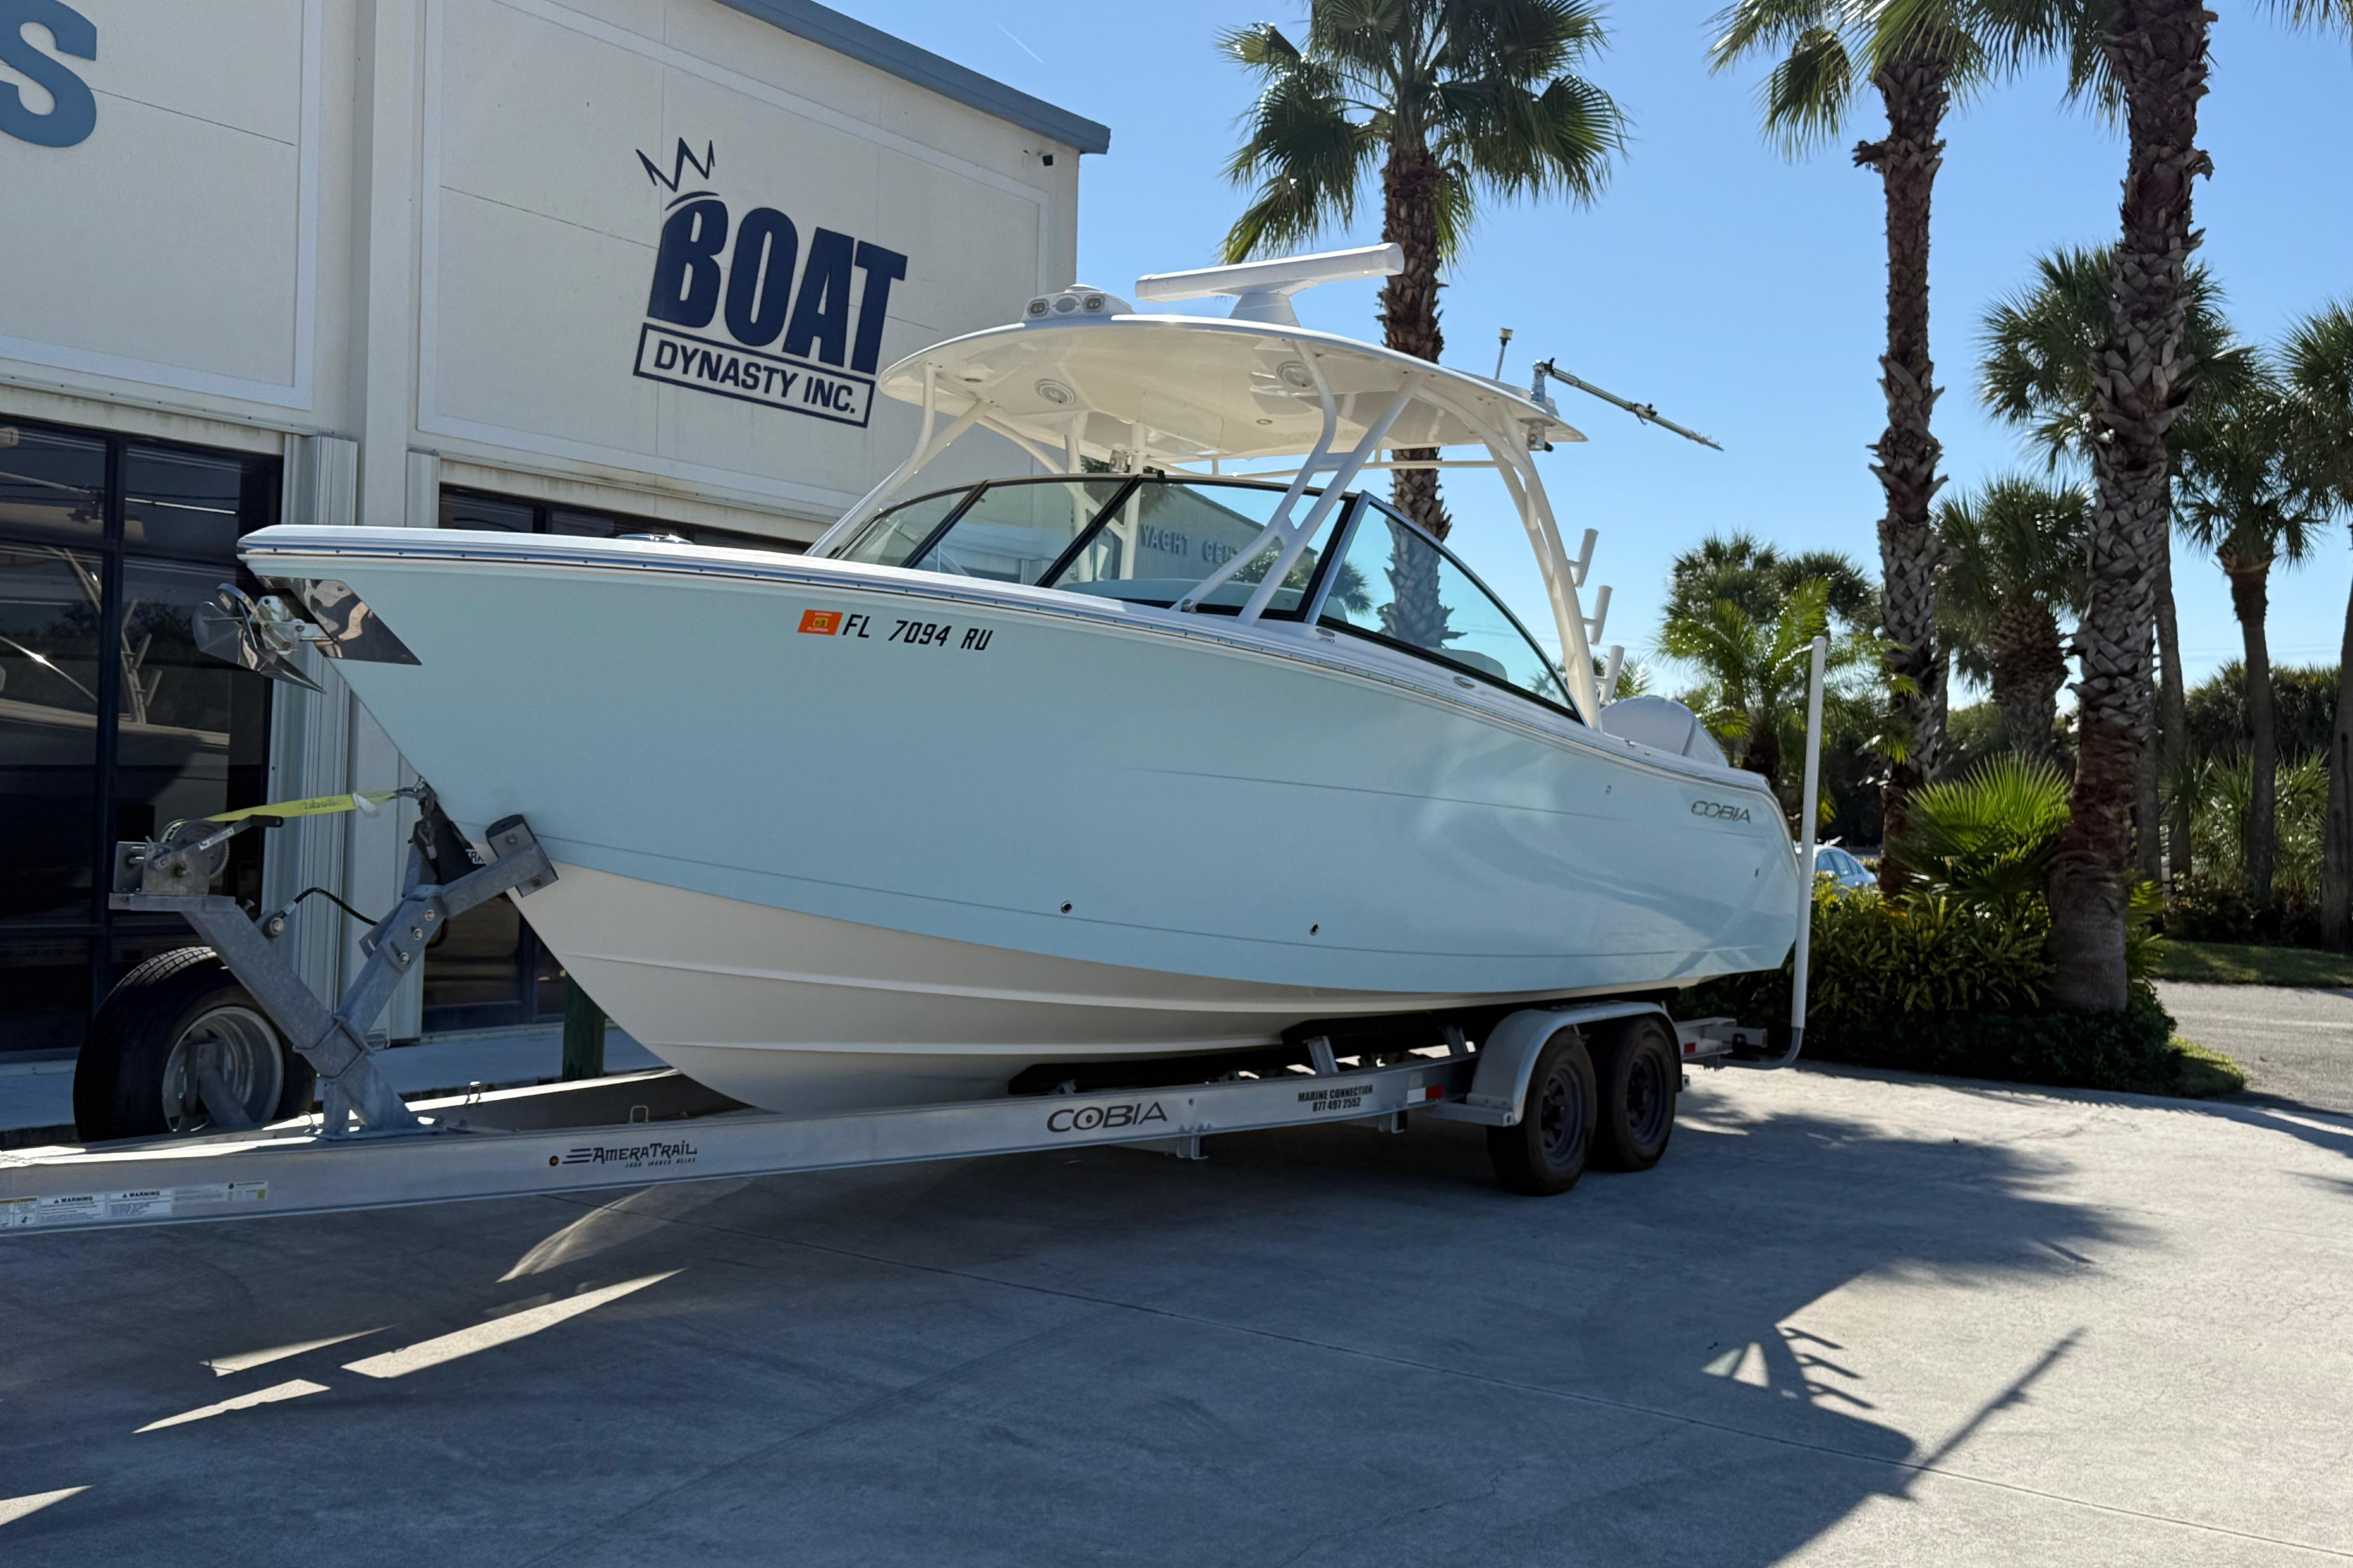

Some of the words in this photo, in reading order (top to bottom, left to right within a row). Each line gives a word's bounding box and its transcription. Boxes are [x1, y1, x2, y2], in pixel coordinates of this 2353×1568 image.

[0, 0, 97, 148] S
[646, 199, 908, 375] BOAT
[654, 339, 798, 398] DYNASTY
[803, 377, 856, 414] INC.
[1141, 524, 1191, 555] YACHT
[842, 614, 870, 638] FL
[888, 619, 952, 647] 7094
[960, 628, 994, 651] RU
[1691, 800, 1750, 824] COBIA
[1298, 1089, 1328, 1102] MARINE
[1330, 1084, 1373, 1099] CONNECTION
[1312, 1101, 1327, 1112] 877
[1327, 1099, 1341, 1110] 497
[1342, 1097, 1361, 1108] 2552
[1046, 1101, 1168, 1133] COBIA
